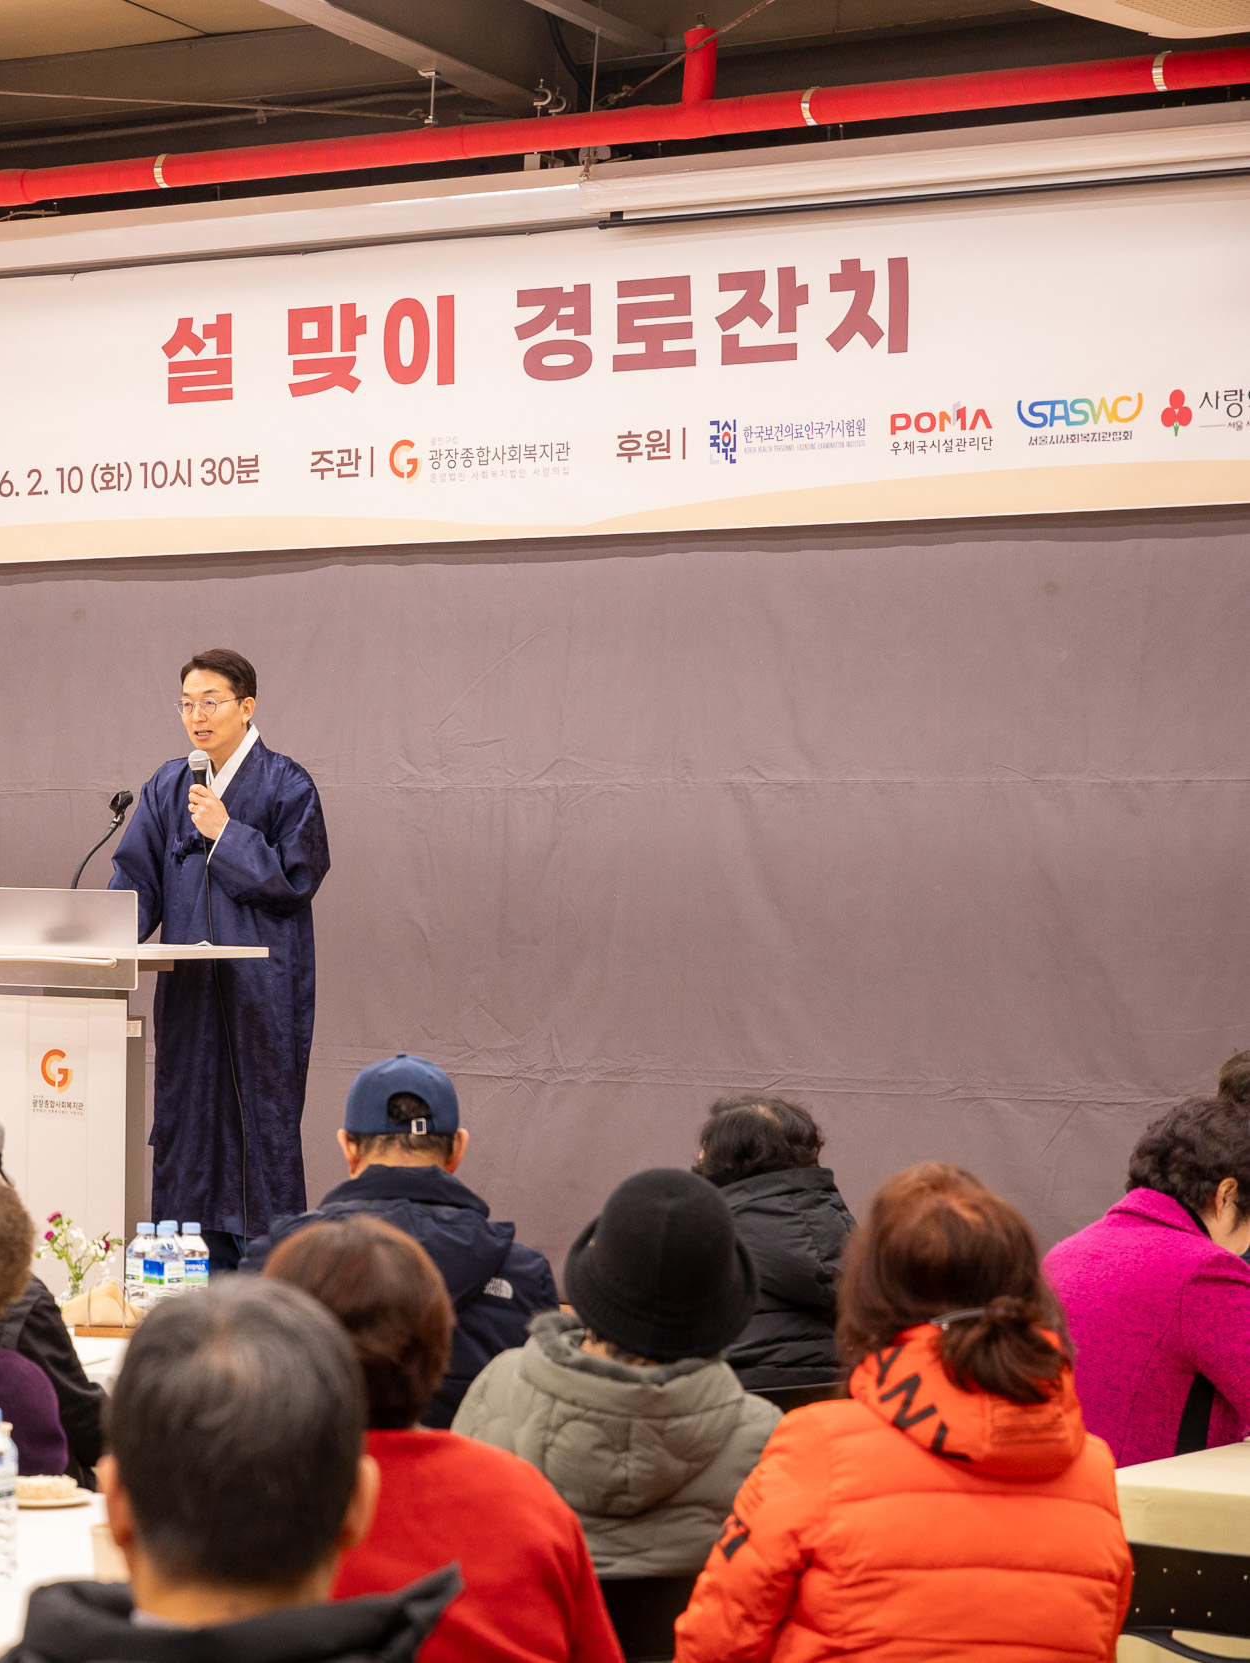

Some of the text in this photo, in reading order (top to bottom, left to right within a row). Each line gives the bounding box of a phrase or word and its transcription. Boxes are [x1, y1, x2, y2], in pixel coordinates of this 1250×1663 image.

[161, 255, 910, 405] 설 맞이 경로잔치
[1198, 388, 1250, 418] 사랑
[743, 417, 866, 444] 한국보건의료인국가시험원
[890, 403, 993, 435] POMA
[616, 428, 671, 463] 후원
[890, 436, 993, 456] 우체국시설관리단
[1028, 430, 1133, 446] 서울시사회복지관협회
[310, 447, 362, 481] 주관
[428, 441, 571, 470] 광장종합사회복지관
[26, 468, 49, 497] 2.
[56, 465, 84, 495] 10
[90, 461, 133, 494] (화)
[139, 457, 192, 492] 10시
[200, 453, 261, 487] 30분
